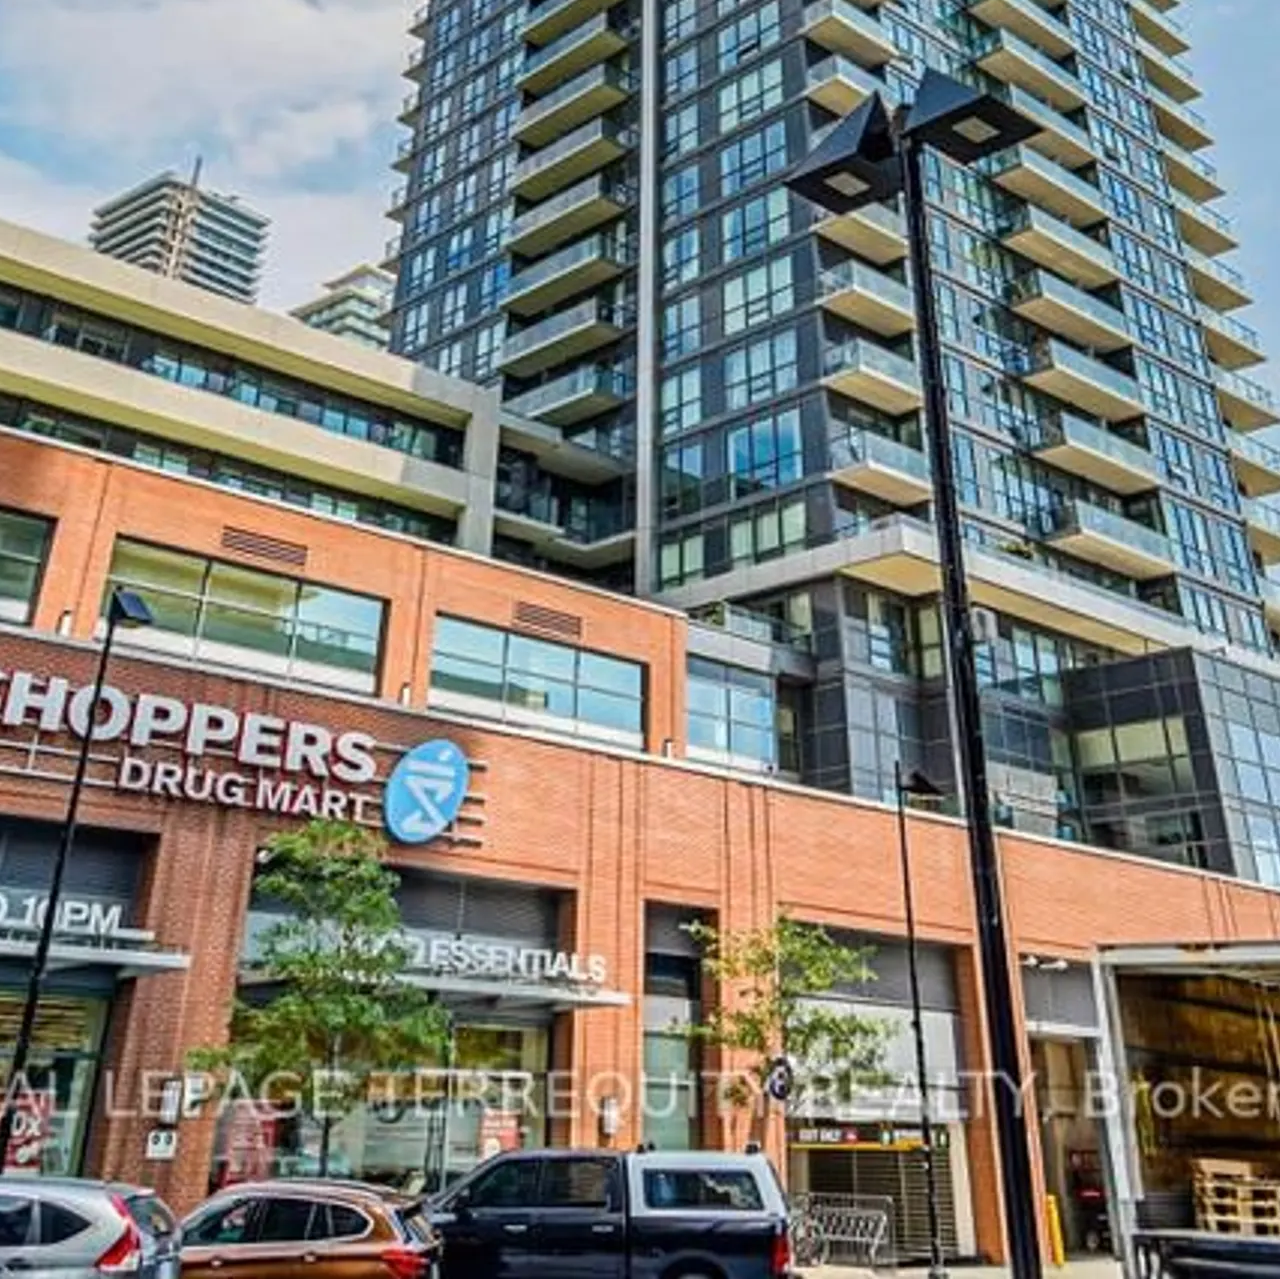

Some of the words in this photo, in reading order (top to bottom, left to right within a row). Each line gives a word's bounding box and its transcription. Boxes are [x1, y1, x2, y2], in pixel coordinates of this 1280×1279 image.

[119, 755, 245, 805] DRUG
[255, 778, 376, 823] MART
[429, 940, 607, 983] ESSENTIALS
